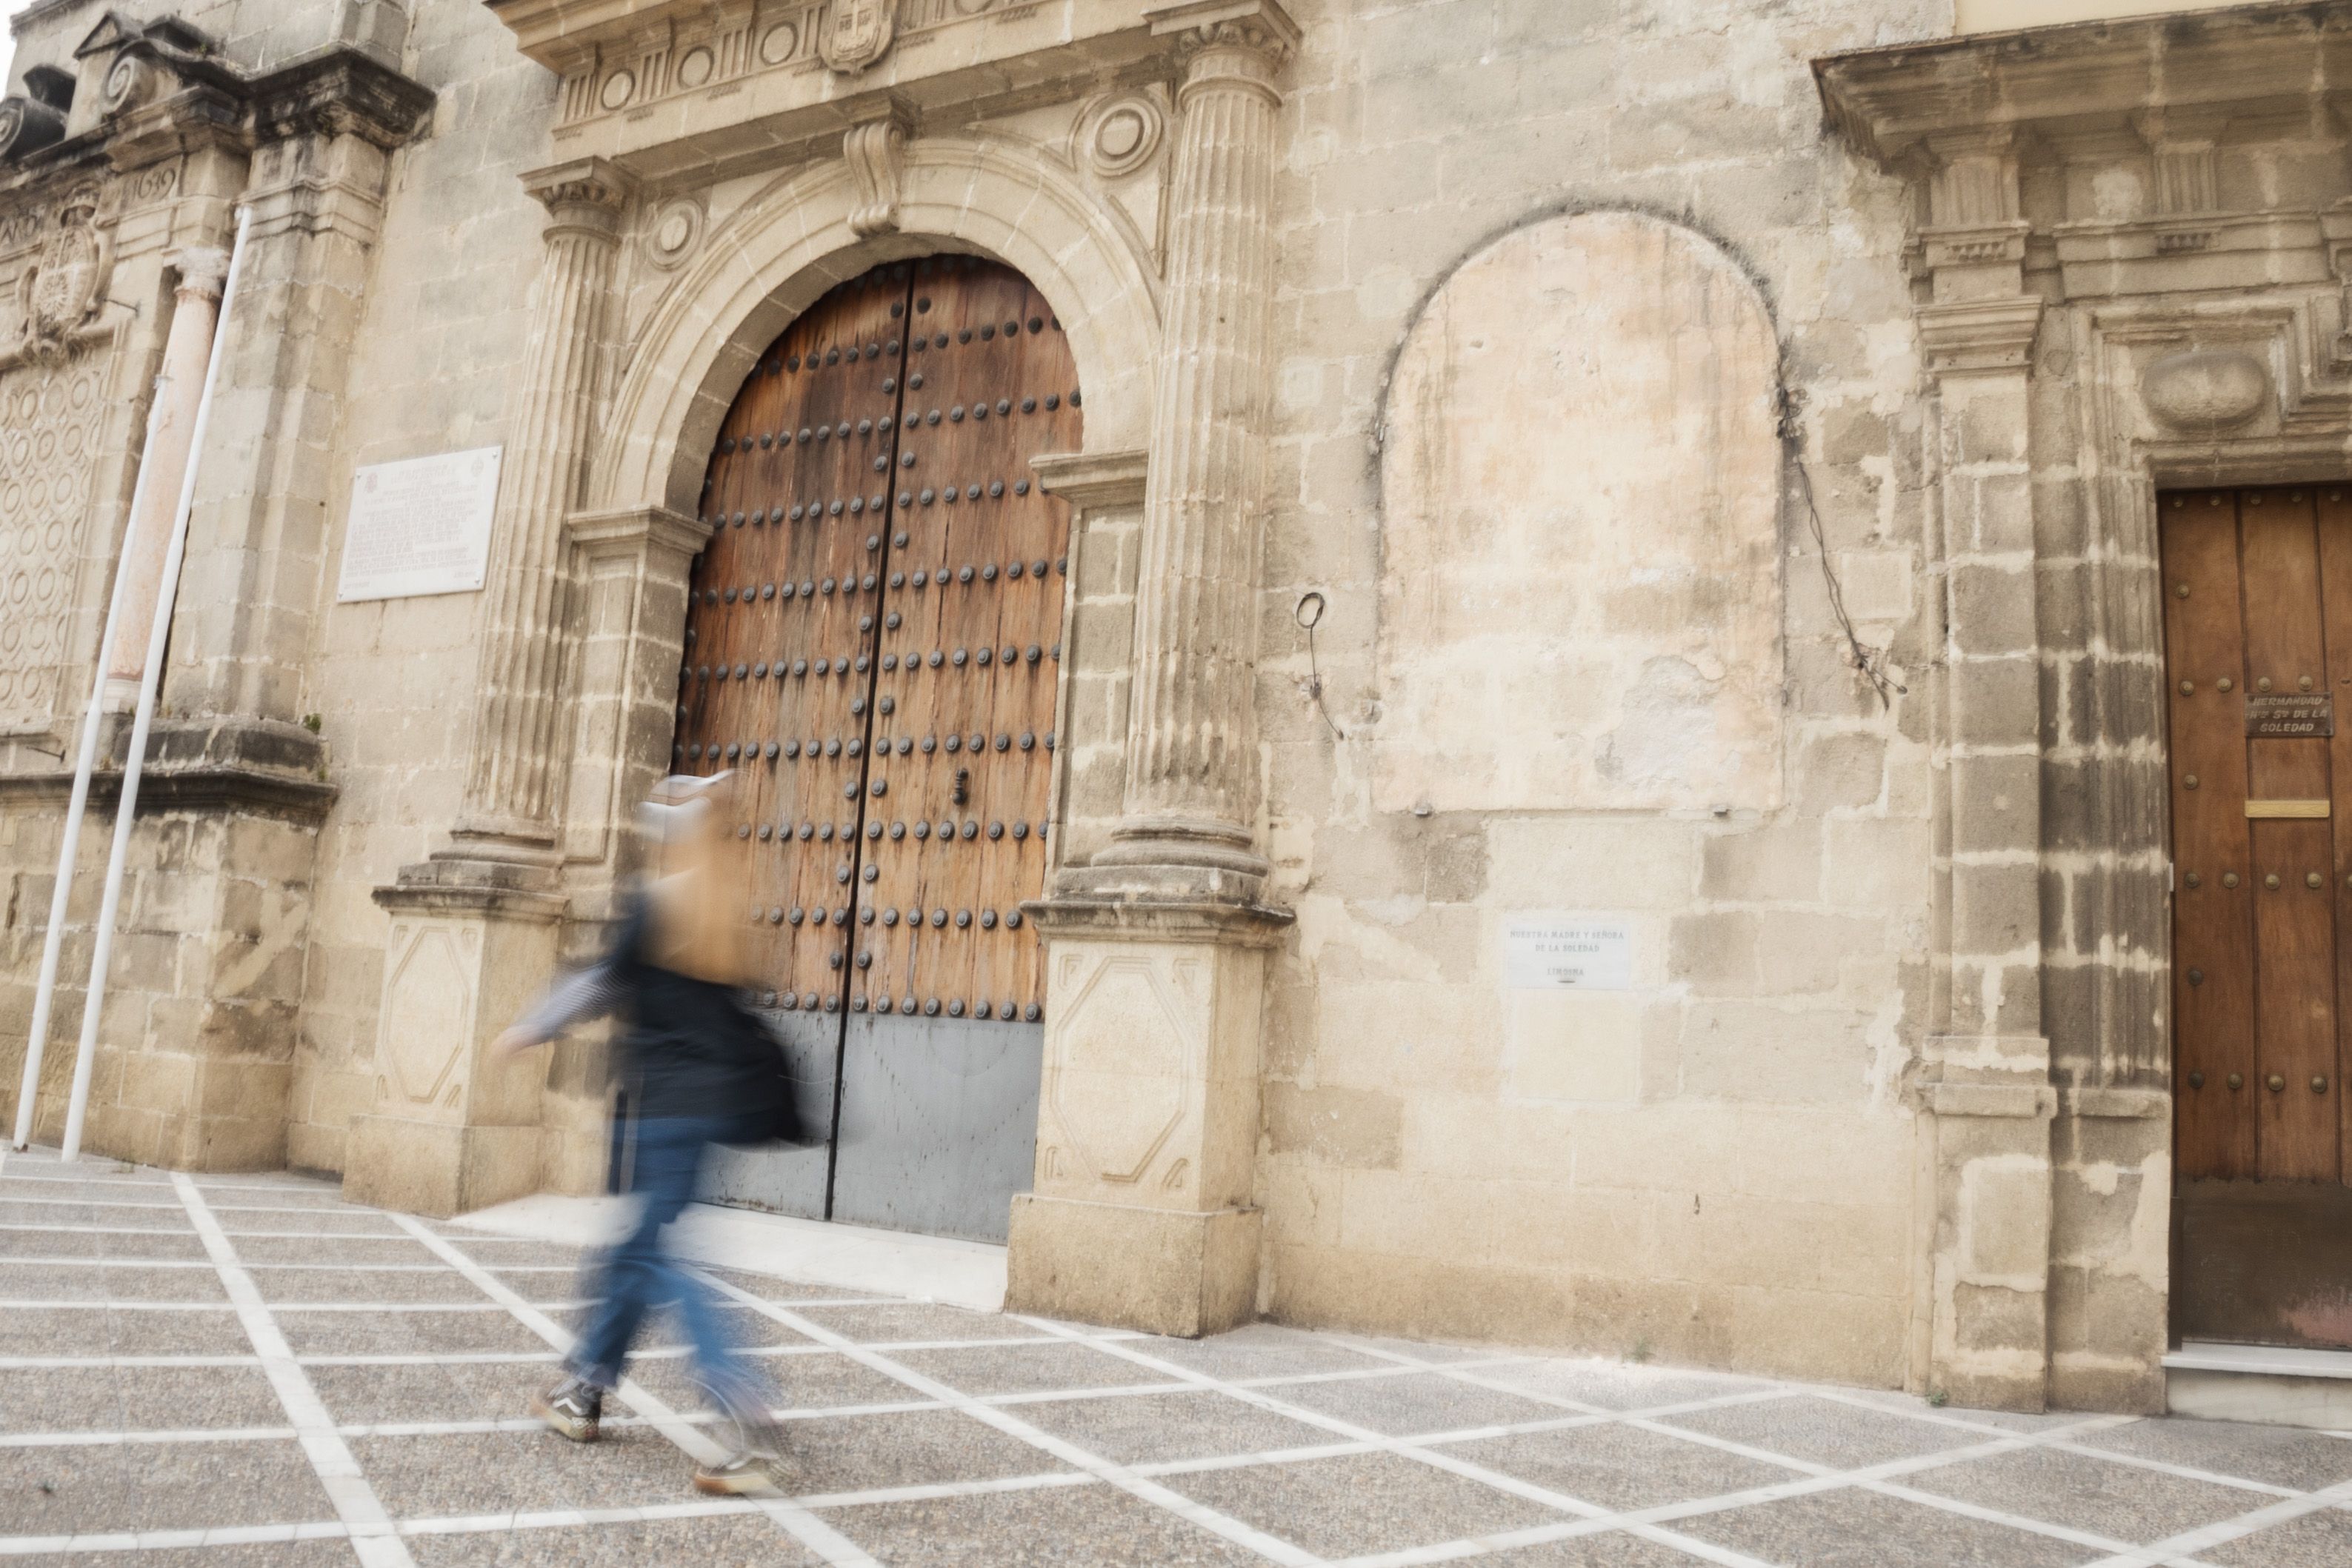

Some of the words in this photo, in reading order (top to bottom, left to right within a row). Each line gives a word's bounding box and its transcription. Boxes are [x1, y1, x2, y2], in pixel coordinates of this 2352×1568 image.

[2253, 696, 2323, 705] HERMANDAD
[2293, 710, 2309, 718] DE
[2312, 710, 2328, 718] LA
[2259, 723, 2314, 732] SOLEDAD
[1510, 930, 1548, 939] NUESTRA
[1551, 930, 1580, 939] MADRE
[1584, 930, 1590, 939] Y
[1592, 930, 1624, 940] SEÑORA
[1563, 944, 1599, 953] SOLEDAD
[1547, 968, 1585, 976] LIMOSNA
